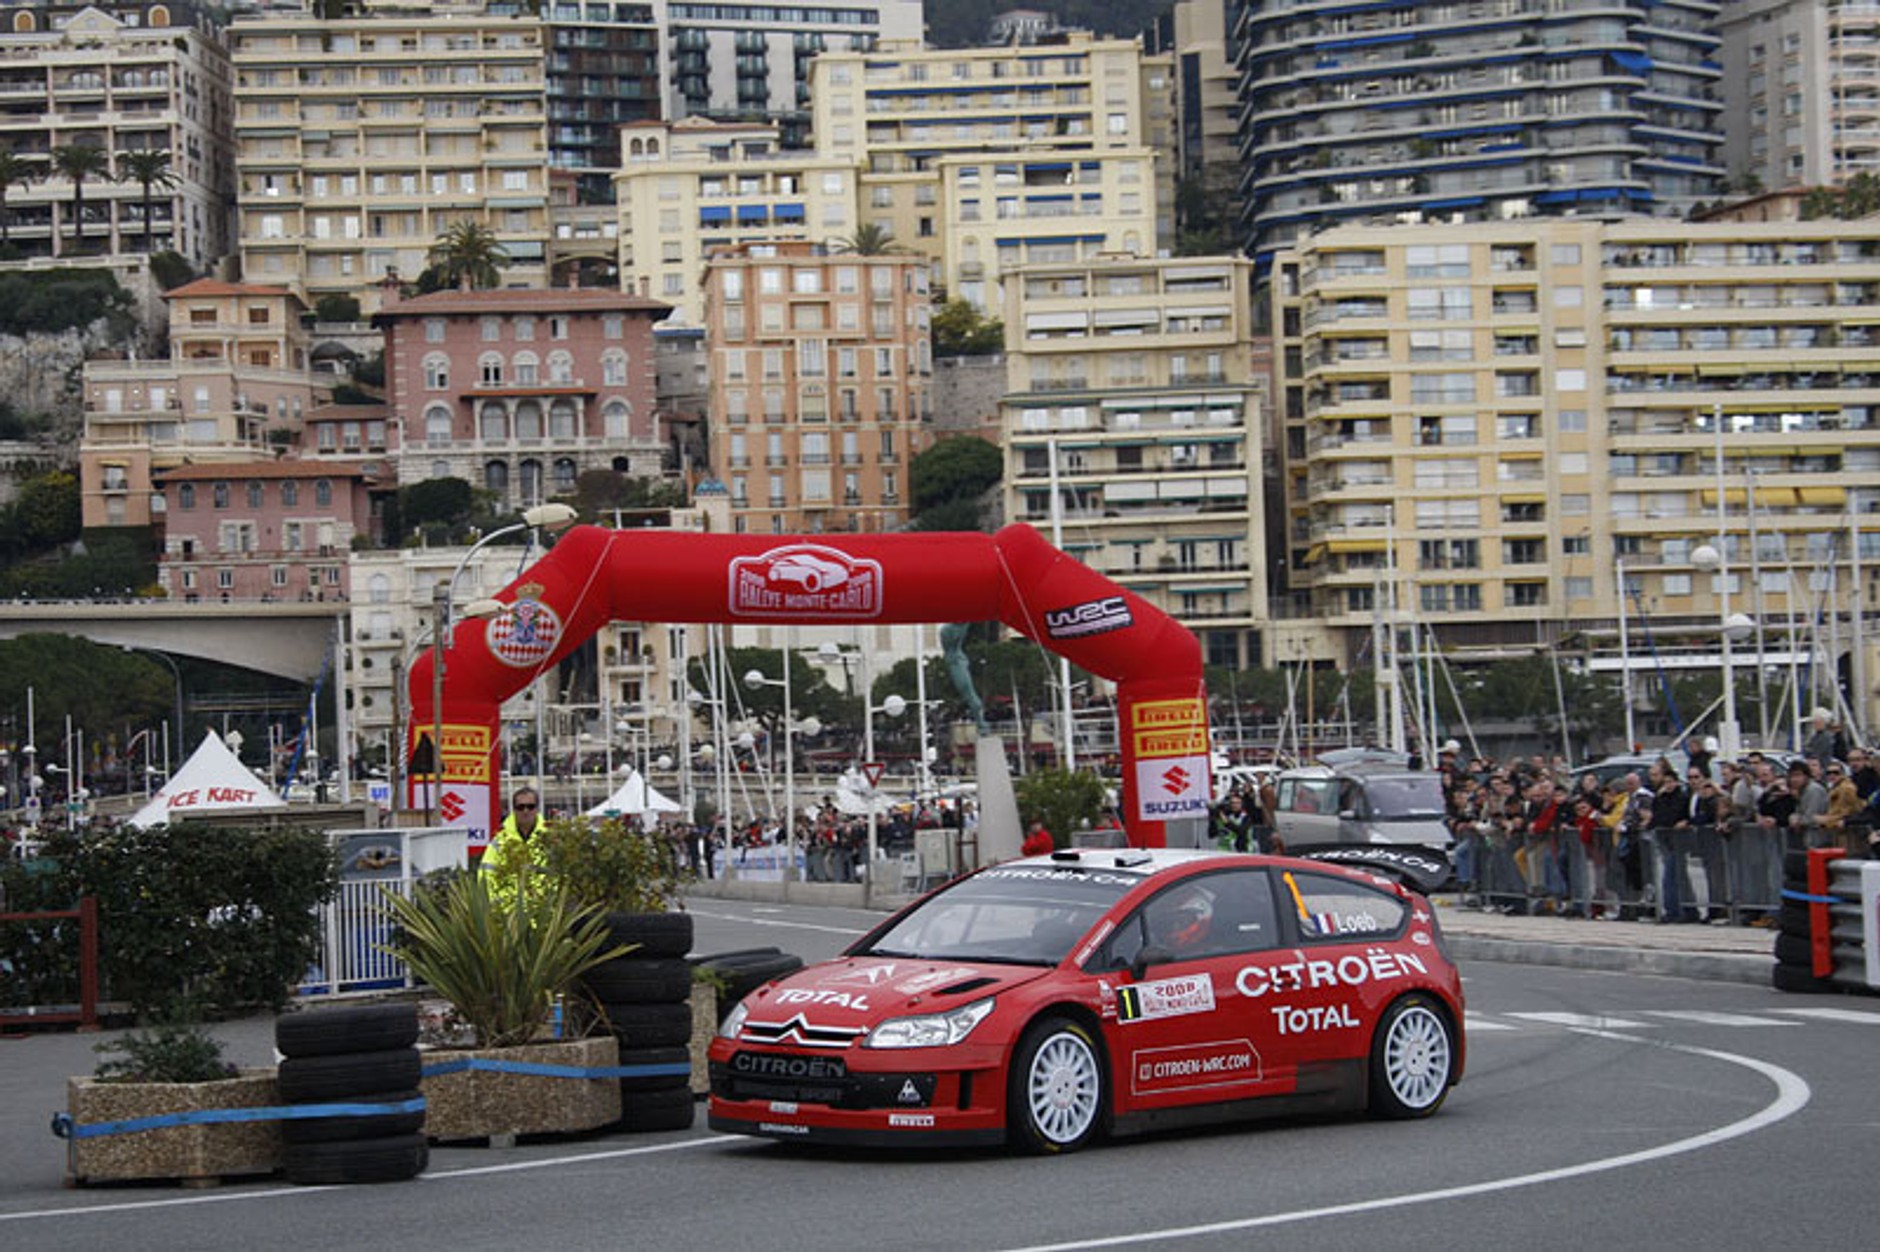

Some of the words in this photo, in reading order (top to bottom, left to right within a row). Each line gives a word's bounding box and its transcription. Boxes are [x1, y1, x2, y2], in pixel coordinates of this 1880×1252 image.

[1046, 597, 1128, 627] WRC
[1138, 703, 1201, 724] PIRELLI
[1140, 732, 1203, 753] PIRELLI
[167, 789, 201, 808] ICE
[206, 787, 257, 803] KART
[1335, 911, 1377, 932] Loeb
[1235, 948, 1428, 998] CITROËN
[776, 988, 870, 1012] TOTAL
[1154, 982, 1196, 998] 2008
[1121, 989, 1134, 1020] 1
[1271, 1003, 1361, 1035] TOTAL
[735, 1053, 847, 1078] CITROËN
[1153, 1054, 1251, 1078] CITROEN-WRC.COM
